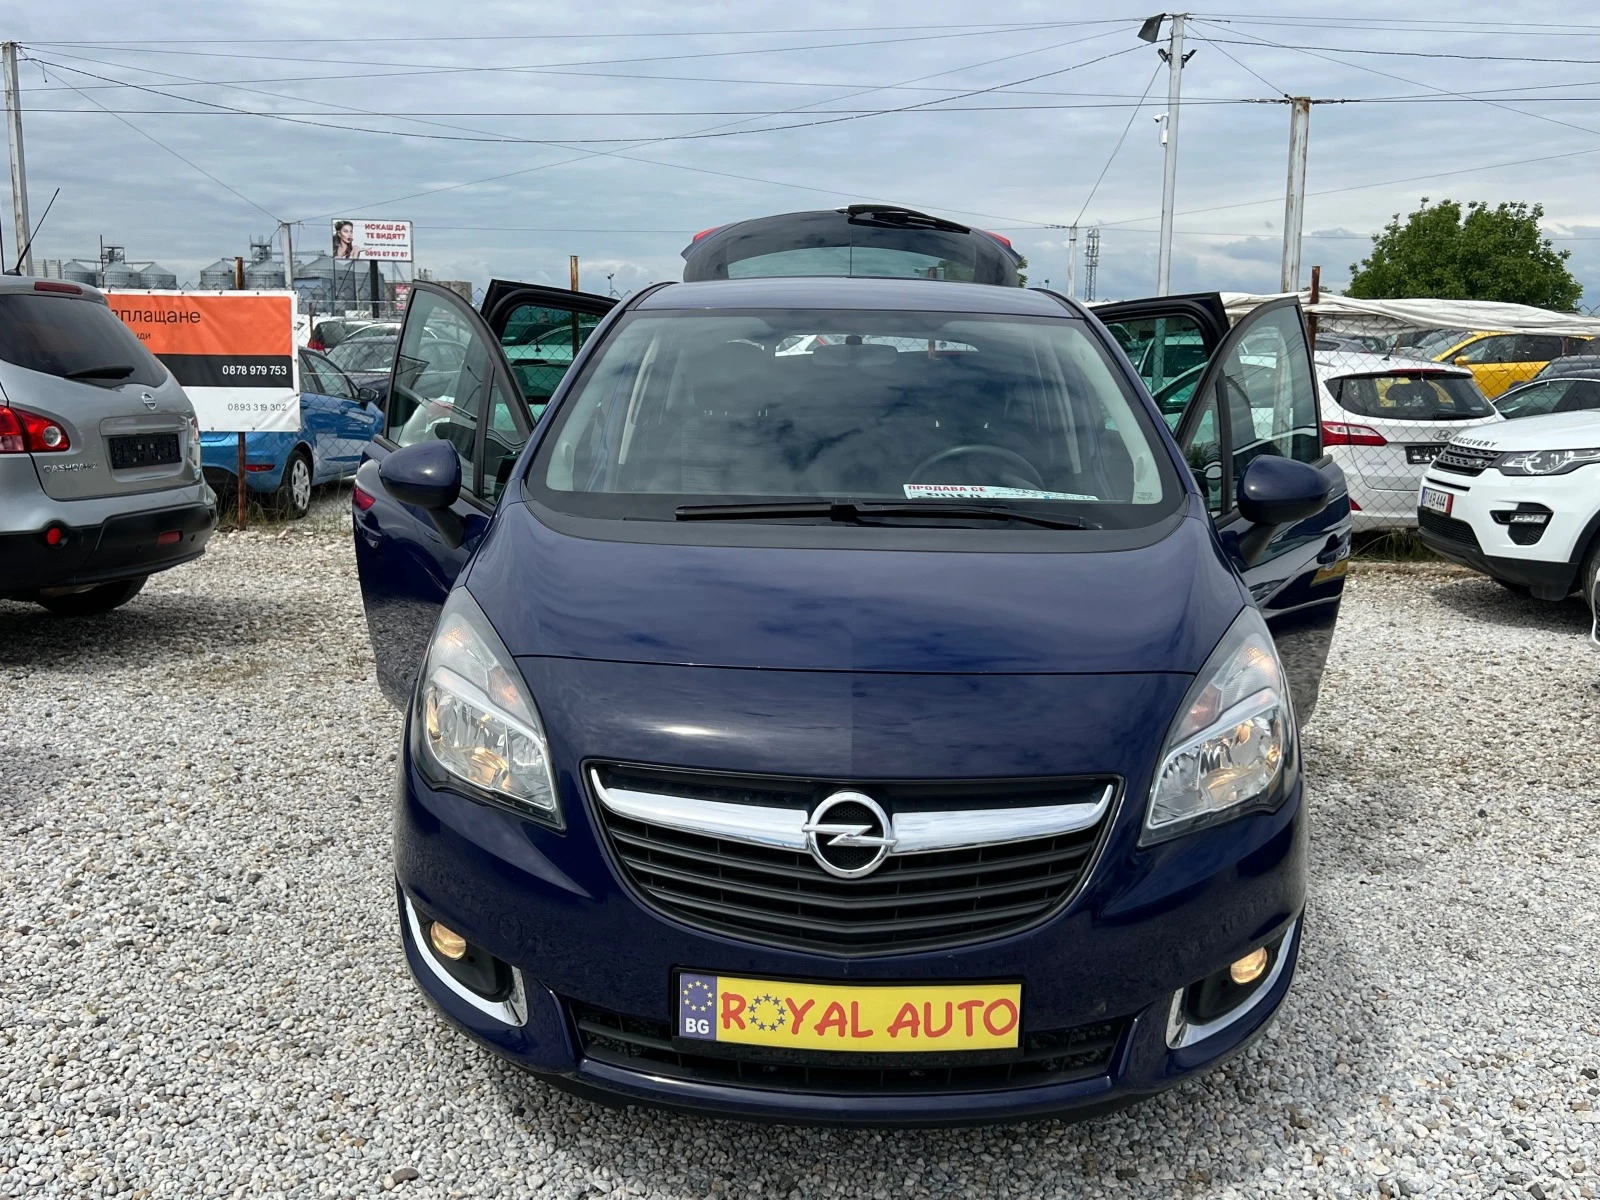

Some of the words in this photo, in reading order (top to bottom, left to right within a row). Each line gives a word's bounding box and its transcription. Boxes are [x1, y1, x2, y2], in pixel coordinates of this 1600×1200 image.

[222, 365, 248, 375] 0878
[249, 365, 268, 375] 979
[270, 365, 288, 375] 753
[228, 403, 250, 411] 0893
[253, 403, 268, 411] 319
[270, 403, 287, 411] 302
[1452, 436, 1498, 448] DISCOVERY
[887, 998, 1018, 1038] AUTO
[685, 1017, 709, 1034] BG
